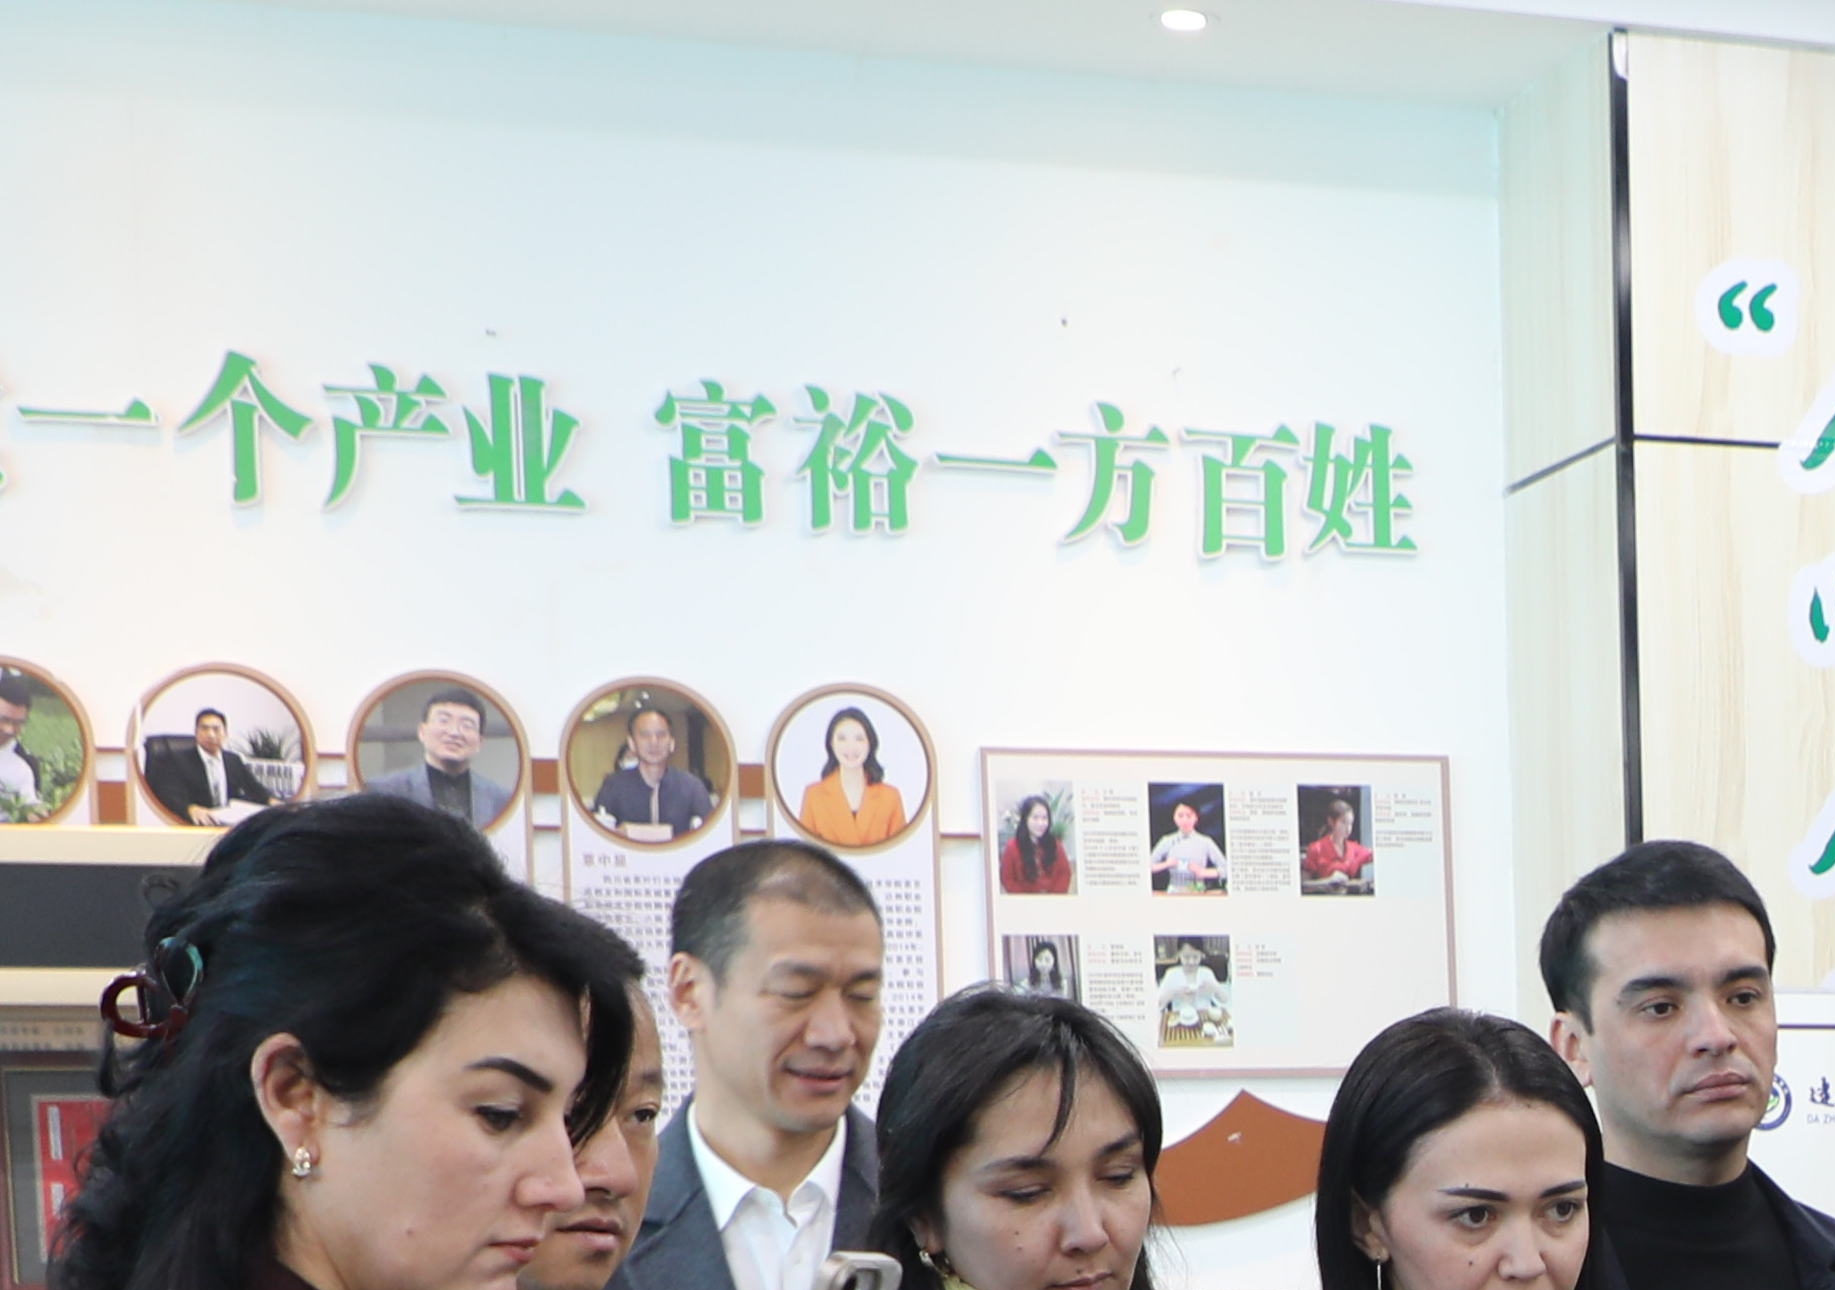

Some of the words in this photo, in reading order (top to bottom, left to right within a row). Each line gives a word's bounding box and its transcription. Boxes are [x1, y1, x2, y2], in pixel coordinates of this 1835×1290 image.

[0, 350, 587, 512] 一个产业
[652, 378, 1419, 561] 富裕一方百姓
[1806, 1114, 1820, 1124] DA
